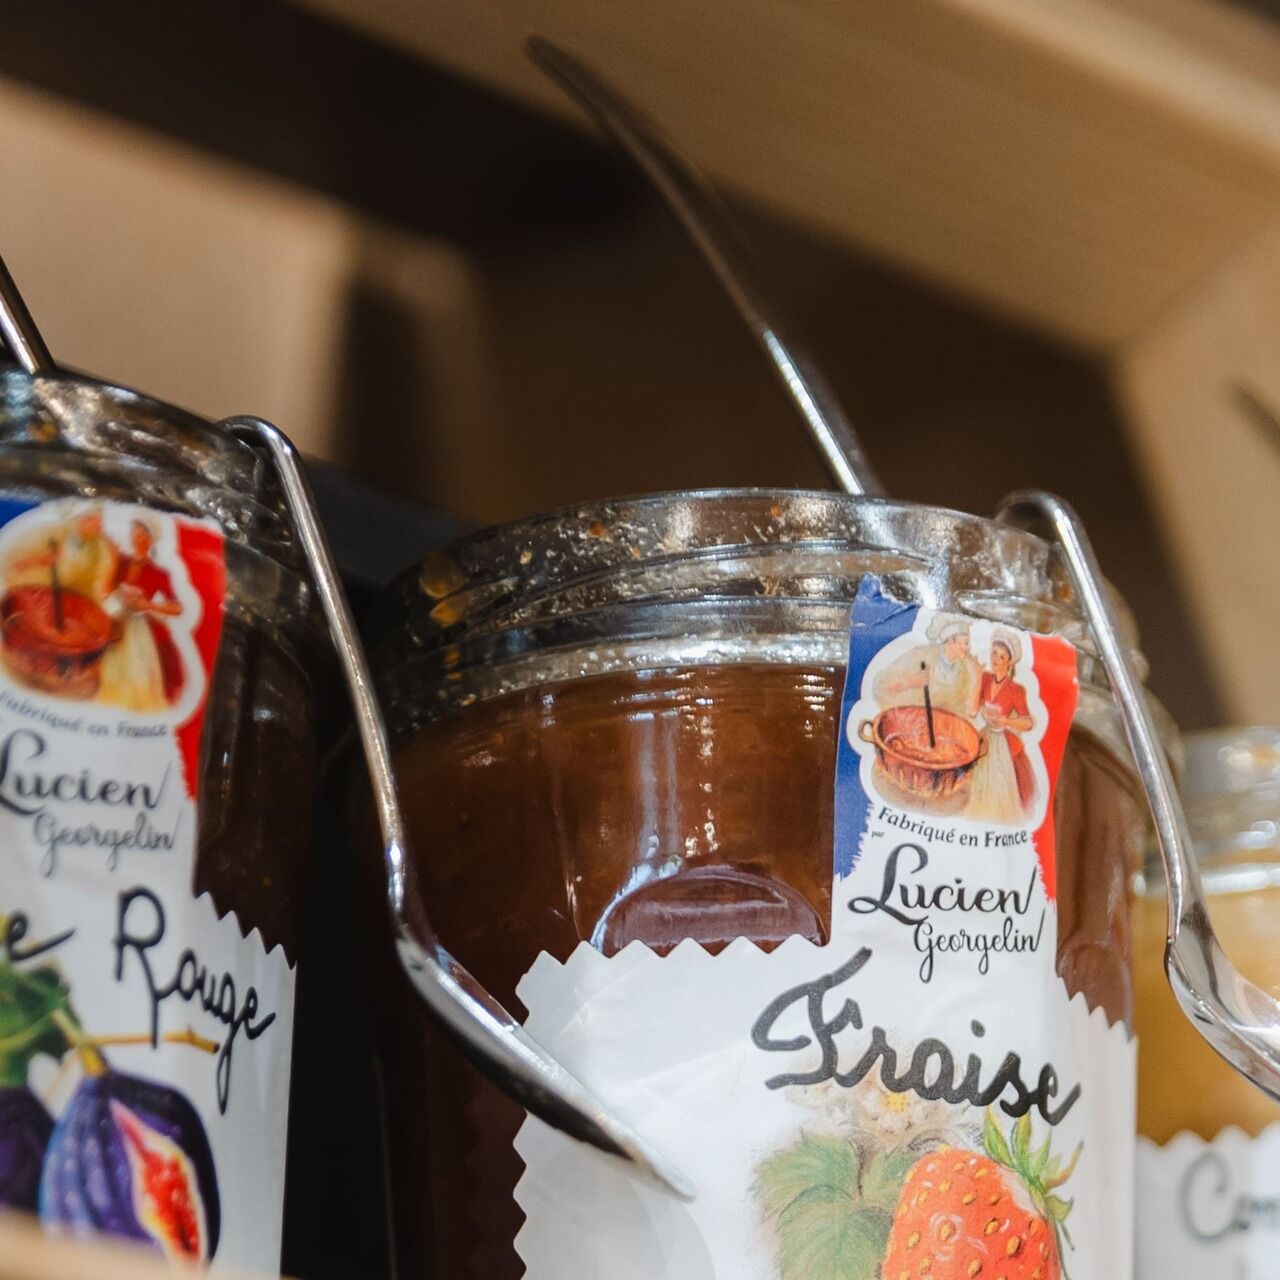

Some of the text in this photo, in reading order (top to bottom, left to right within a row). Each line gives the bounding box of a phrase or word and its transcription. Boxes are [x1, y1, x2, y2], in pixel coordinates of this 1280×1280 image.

[88, 722, 109, 736] en
[0, 728, 172, 815] Lucien
[33, 810, 185, 879] Georgelin
[871, 830, 885, 839] par
[878, 806, 1029, 848] Fabriqué en France
[847, 843, 1038, 926] Lucien
[914, 907, 1046, 984] Georgelin
[112, 885, 276, 1116] Rouge
[751, 947, 1082, 1126] Fraise
